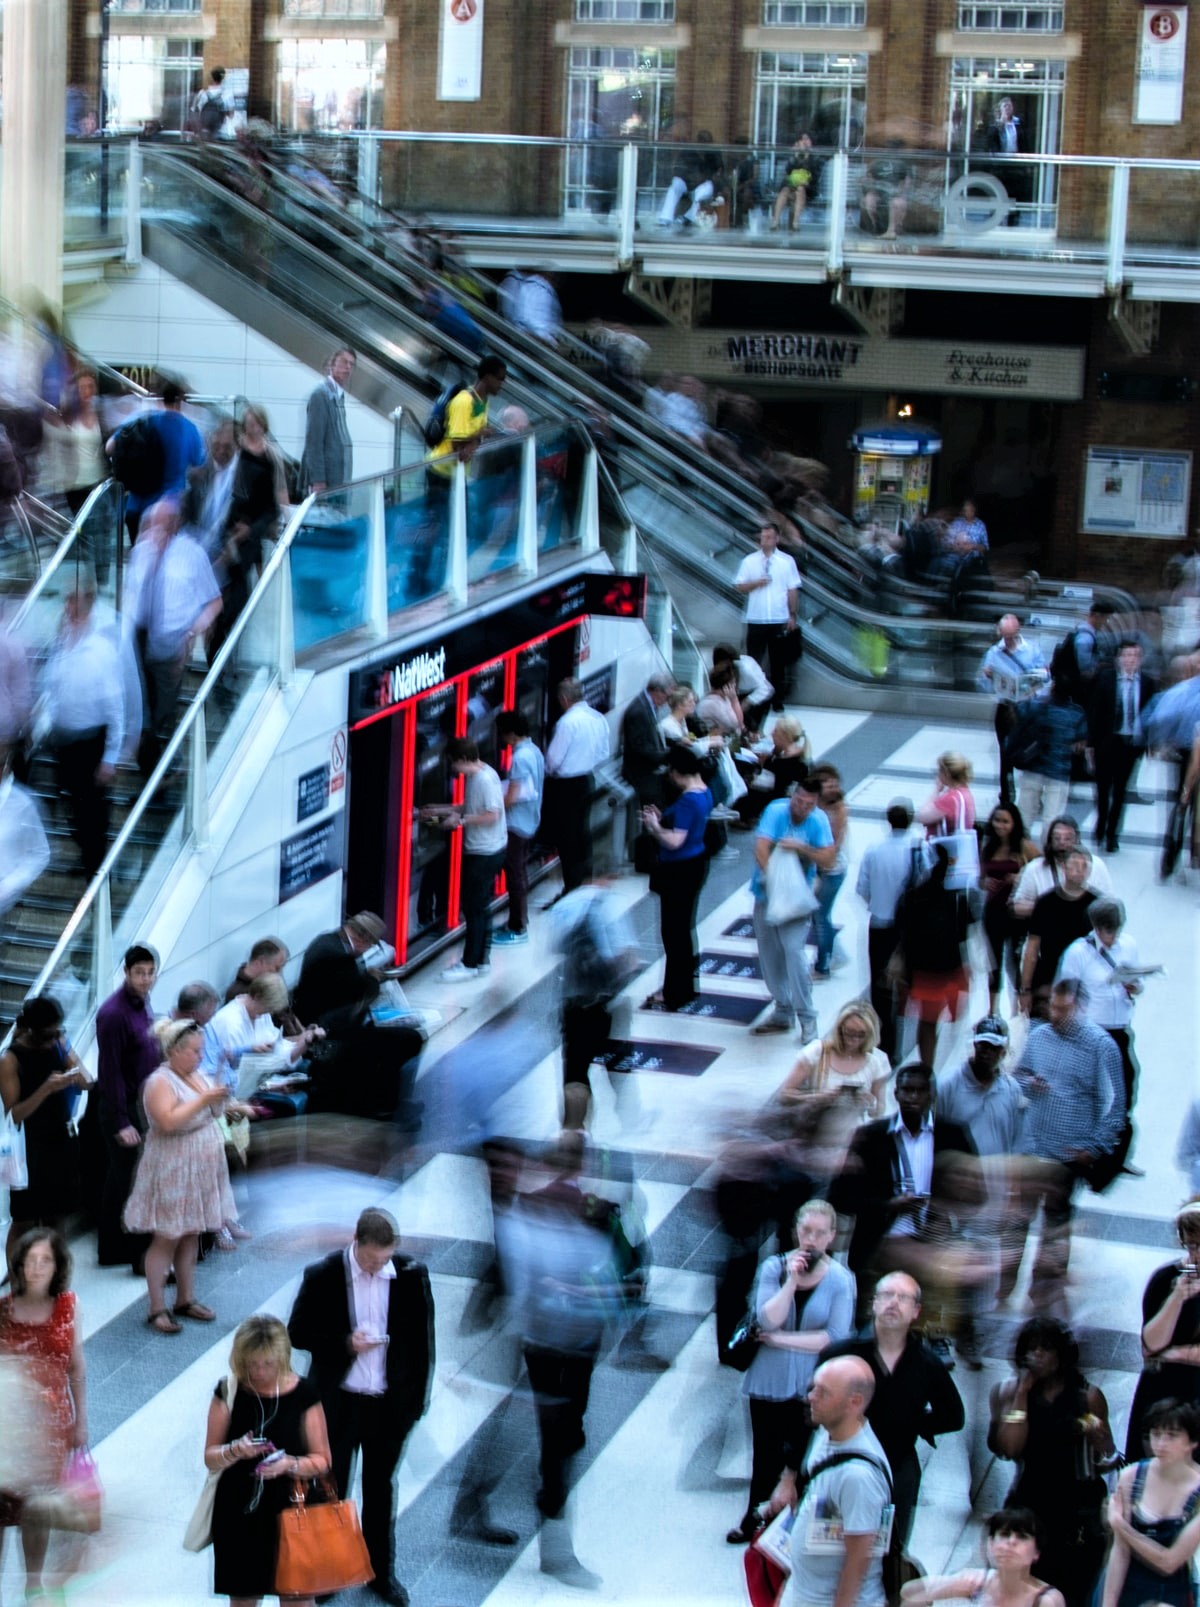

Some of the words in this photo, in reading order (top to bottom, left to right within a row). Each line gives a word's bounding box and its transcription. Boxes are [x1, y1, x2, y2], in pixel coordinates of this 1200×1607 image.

[455, 0, 472, 17] A
[727, 334, 863, 365] MERCHANT
[947, 350, 1032, 369] Freehouse
[744, 360, 842, 379] BISHOPSGATE
[969, 367, 1029, 385] Kitchen
[394, 646, 445, 703] NatWest
